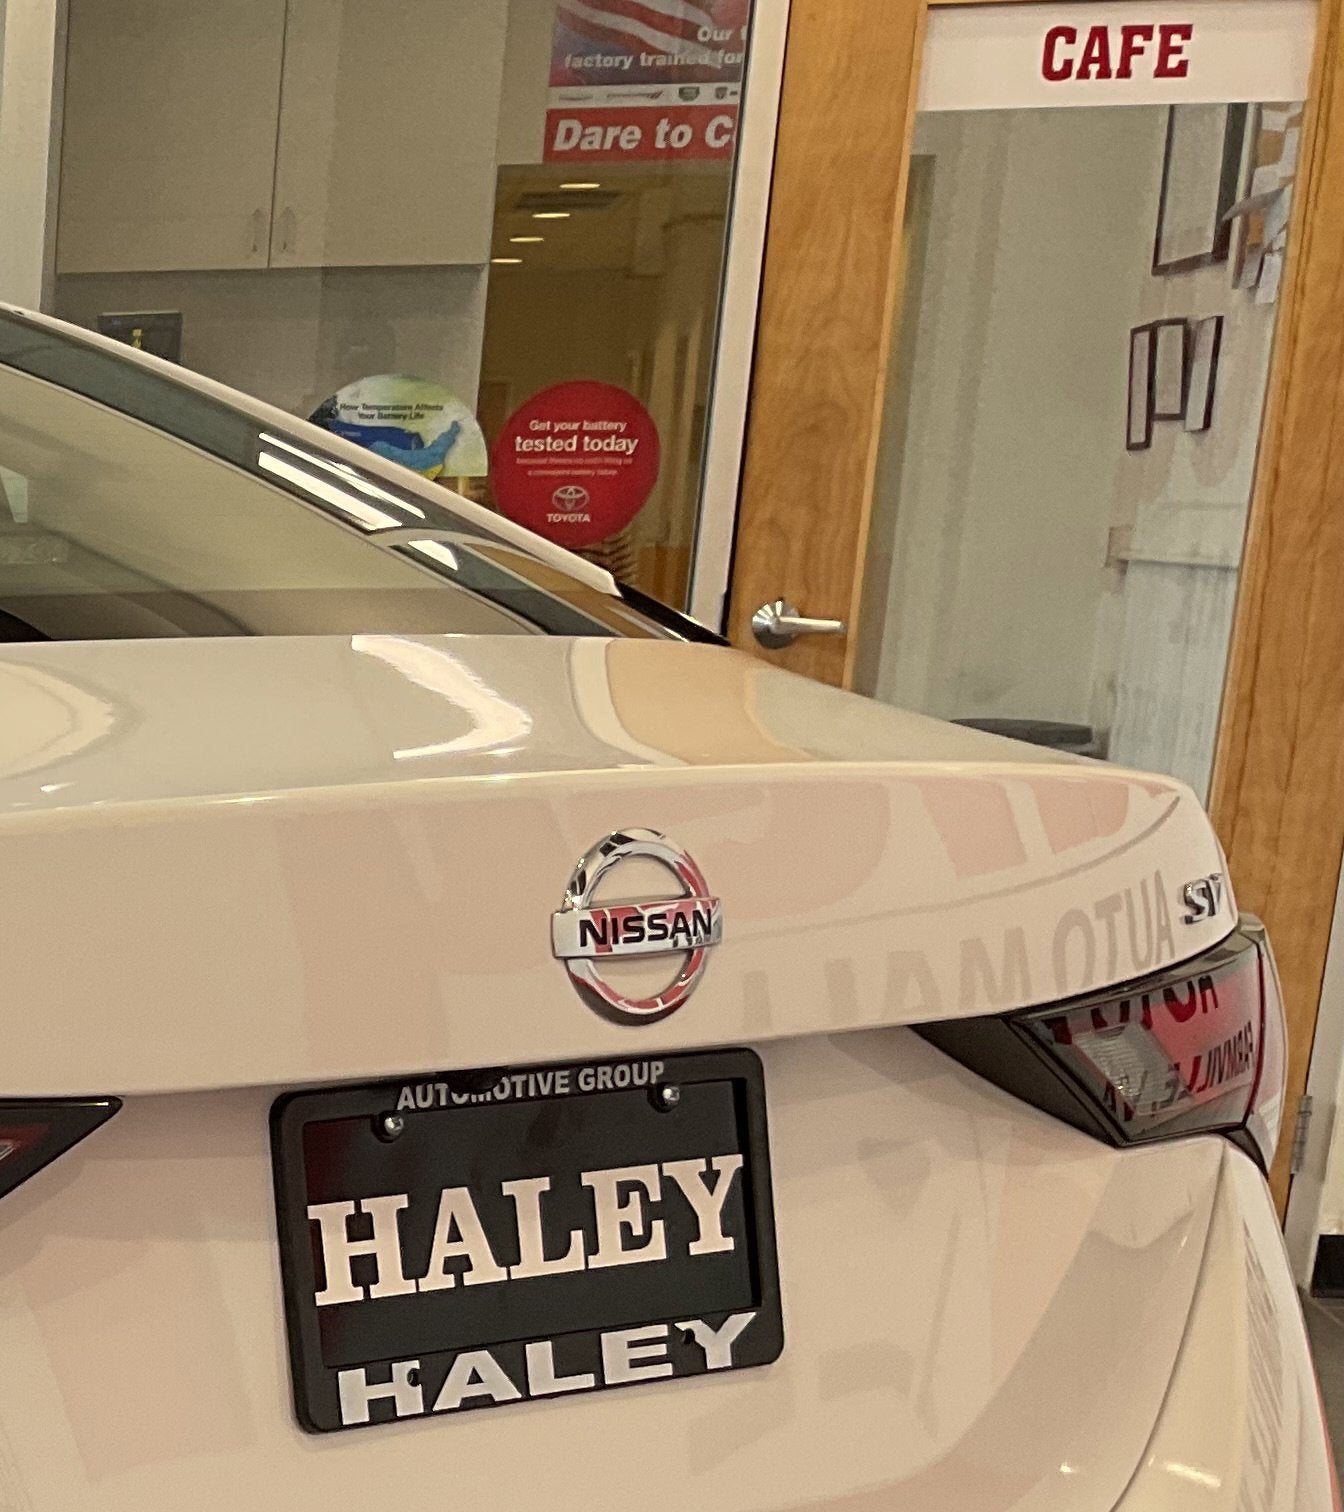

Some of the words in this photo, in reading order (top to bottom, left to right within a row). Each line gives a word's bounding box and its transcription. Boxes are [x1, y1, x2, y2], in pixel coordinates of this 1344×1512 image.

[697, 25, 732, 42] Our
[564, 52, 633, 70] factory
[639, 51, 711, 67] trained
[1042, 24, 1193, 82] CAFE
[553, 118, 642, 151] Dare
[655, 117, 693, 149] to
[705, 114, 736, 149] C
[529, 419, 551, 431] Get
[553, 421, 581, 433] your
[582, 420, 628, 433] battery
[515, 435, 578, 452] tested
[583, 435, 639, 456] today
[546, 513, 591, 523] TOYOTA
[579, 908, 712, 948] NISSAN
[577, 1061, 664, 1091] GROUP
[307, 1153, 744, 1307] HALEY
[338, 1312, 757, 1425] HALEY
